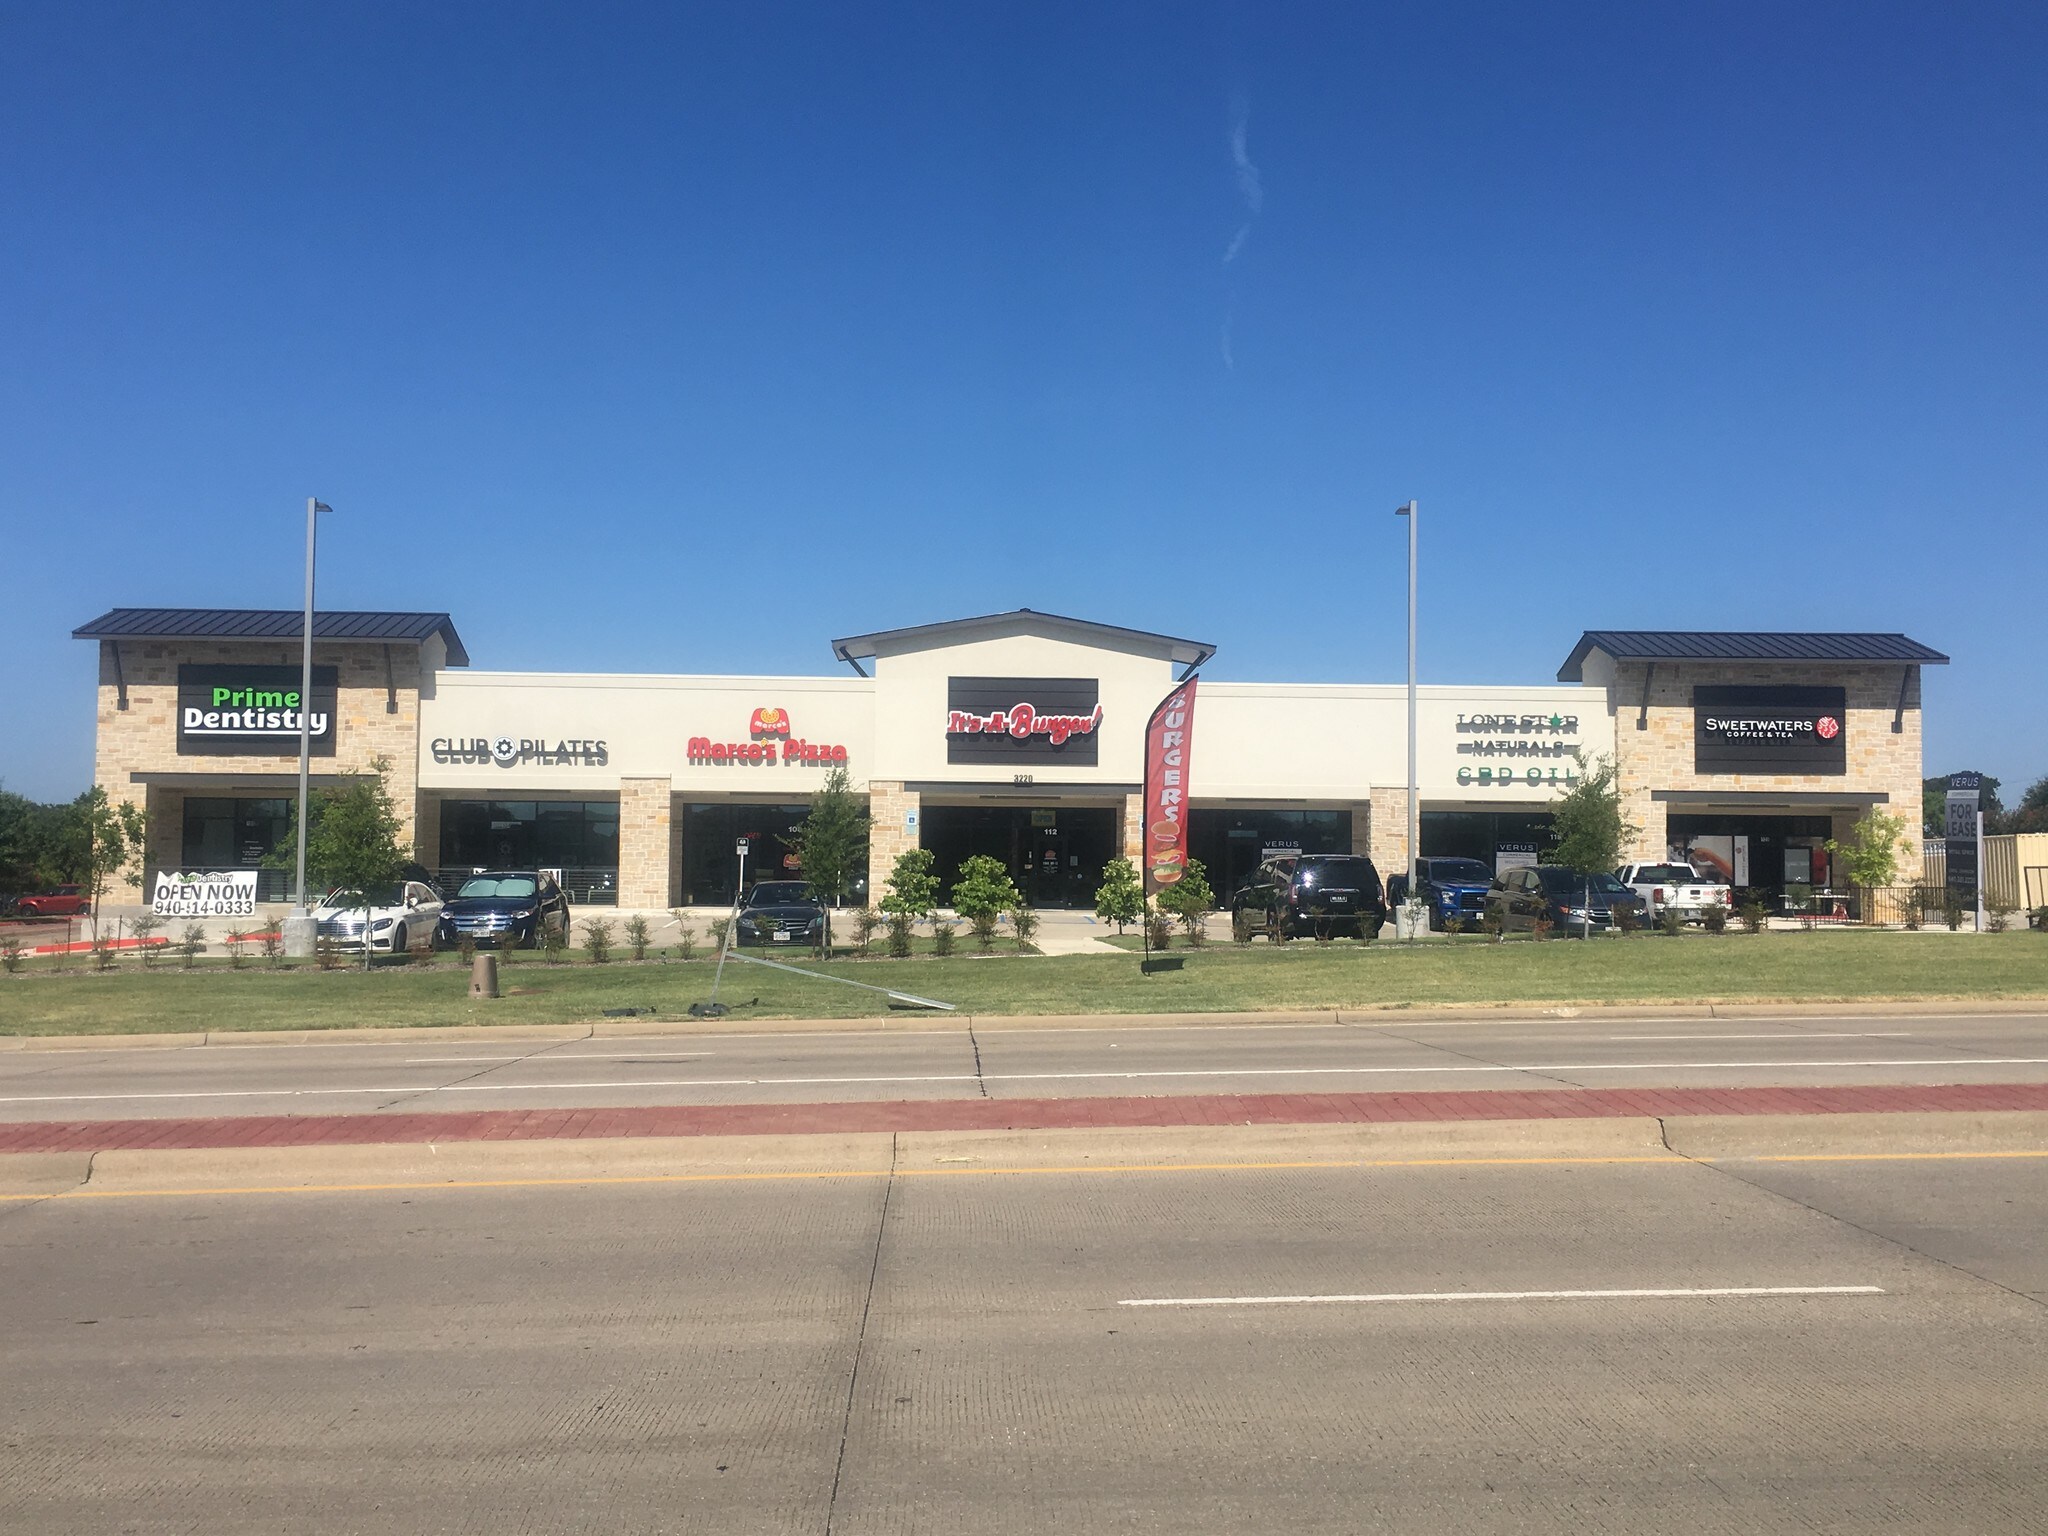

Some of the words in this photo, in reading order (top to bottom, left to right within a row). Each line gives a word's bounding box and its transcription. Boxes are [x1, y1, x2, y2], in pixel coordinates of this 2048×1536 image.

[212, 687, 300, 708] Prime
[184, 707, 327, 735] Dentistry
[1706, 718, 1813, 731] SWEETWATERS
[431, 737, 490, 757] CLUB
[520, 738, 608, 759] PILATES
[687, 736, 777, 760] Marco's
[781, 738, 848, 761] Pizza
[1160, 694, 1185, 823] BURGERS
[1013, 774, 1034, 783] 3220
[1458, 766, 1513, 780] CBD
[1527, 767, 1580, 781] OIL
[1951, 776, 1979, 787] VERUS
[1949, 803, 1973, 819] FOR
[1043, 828, 1058, 836] 112
[1946, 821, 1977, 838] LEASE
[1265, 840, 1299, 848] VERUS
[1499, 844, 1534, 852] VERUS
[156, 884, 202, 900] OPEN
[207, 884, 254, 900] NOW
